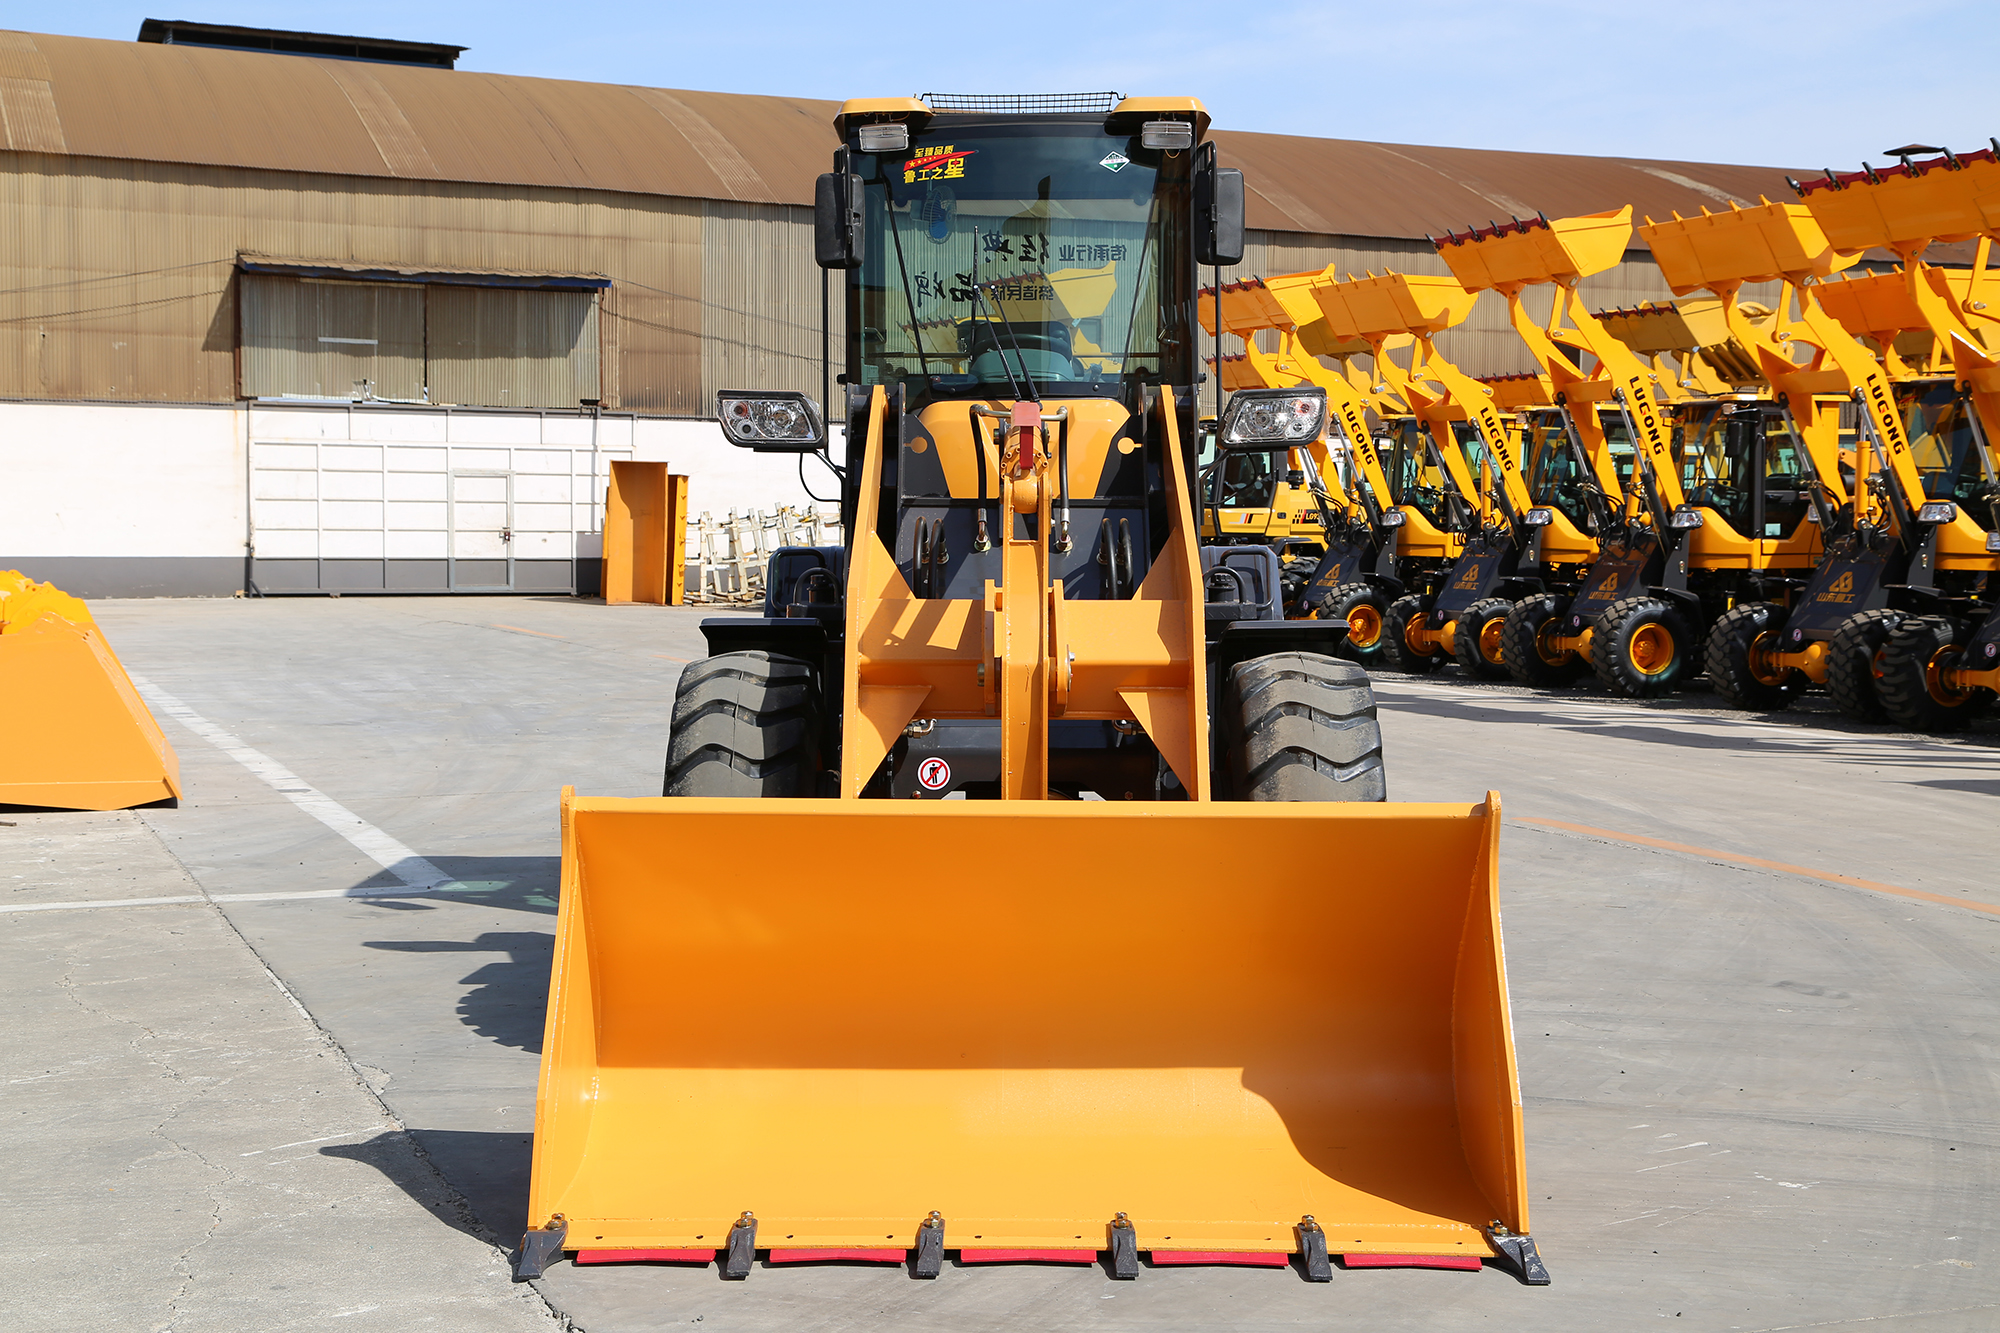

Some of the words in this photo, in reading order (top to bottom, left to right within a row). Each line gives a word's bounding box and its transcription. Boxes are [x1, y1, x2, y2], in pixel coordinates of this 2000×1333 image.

[903, 158, 965, 183] 鲁工之星
[1341, 401, 1375, 465] LUGONG
[1480, 407, 1515, 471] LUGONG
[1629, 376, 1665, 455] LUGONG
[1866, 373, 1905, 455] LUGONG
